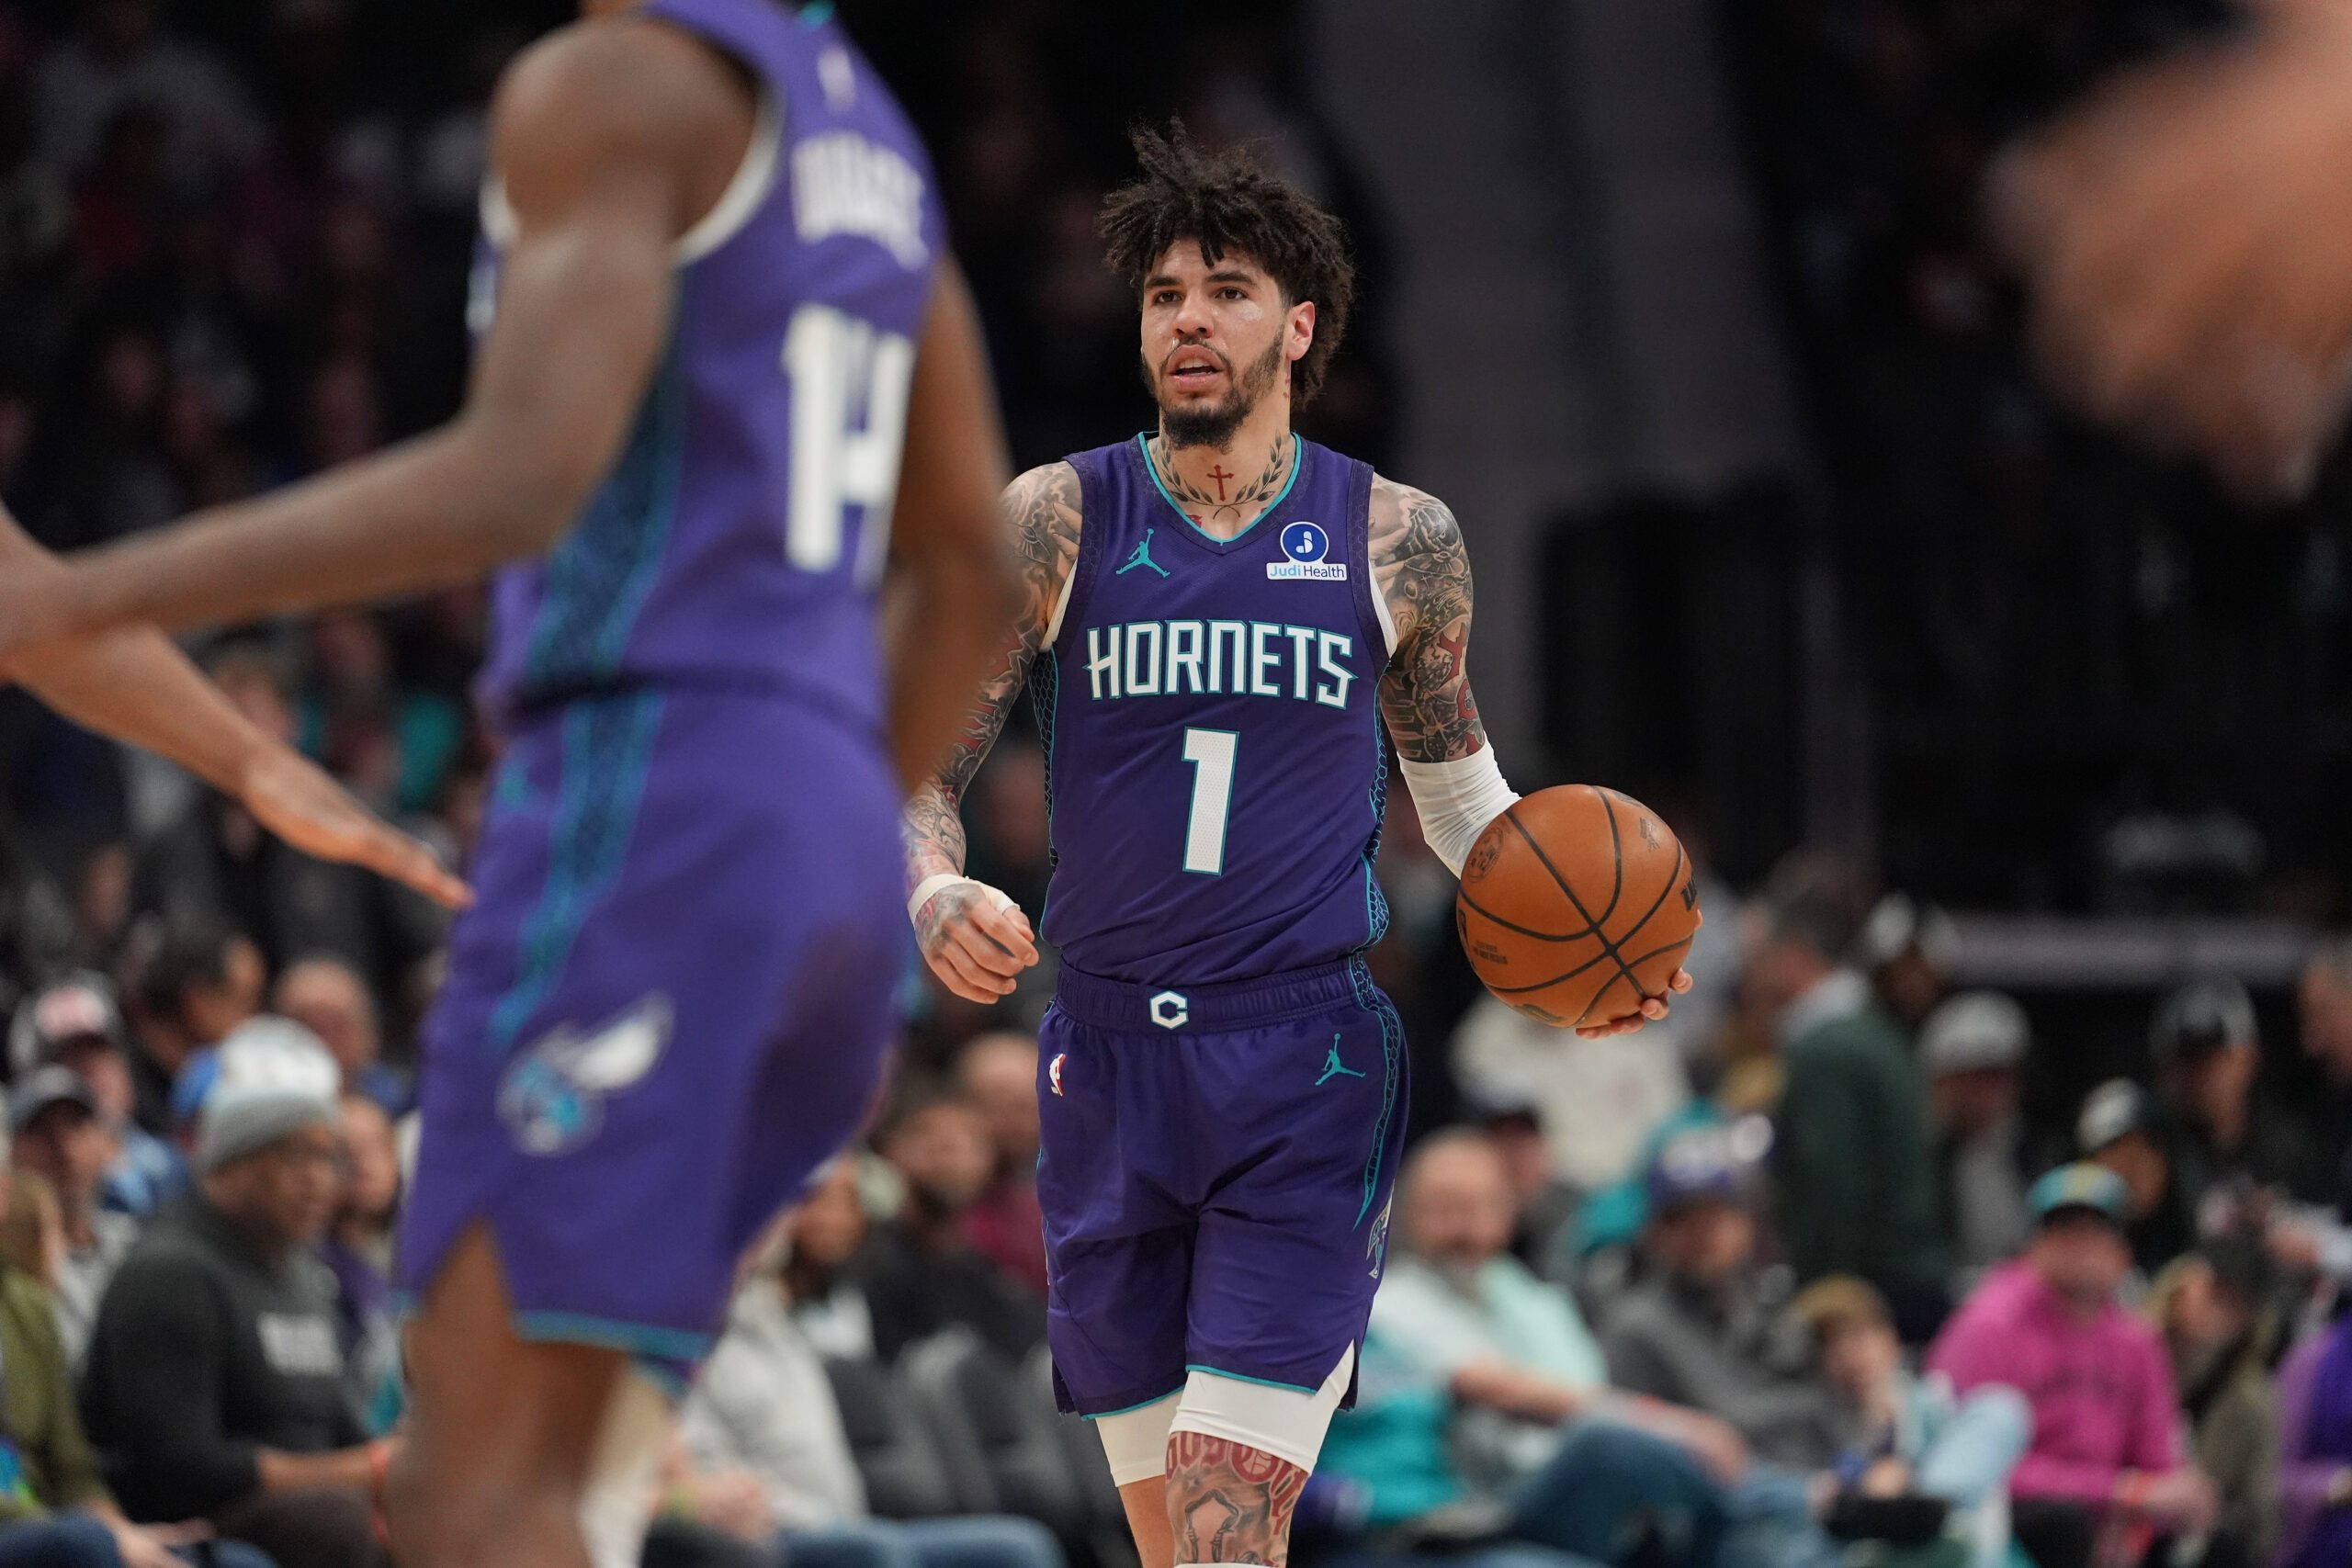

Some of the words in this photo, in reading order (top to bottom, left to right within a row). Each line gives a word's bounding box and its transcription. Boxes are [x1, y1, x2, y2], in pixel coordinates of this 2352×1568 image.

[1270, 565, 1301, 577] Judi
[1304, 565, 1345, 579] Health
[1081, 618, 1359, 710] HORNETS
[1182, 726, 1240, 876] 1
